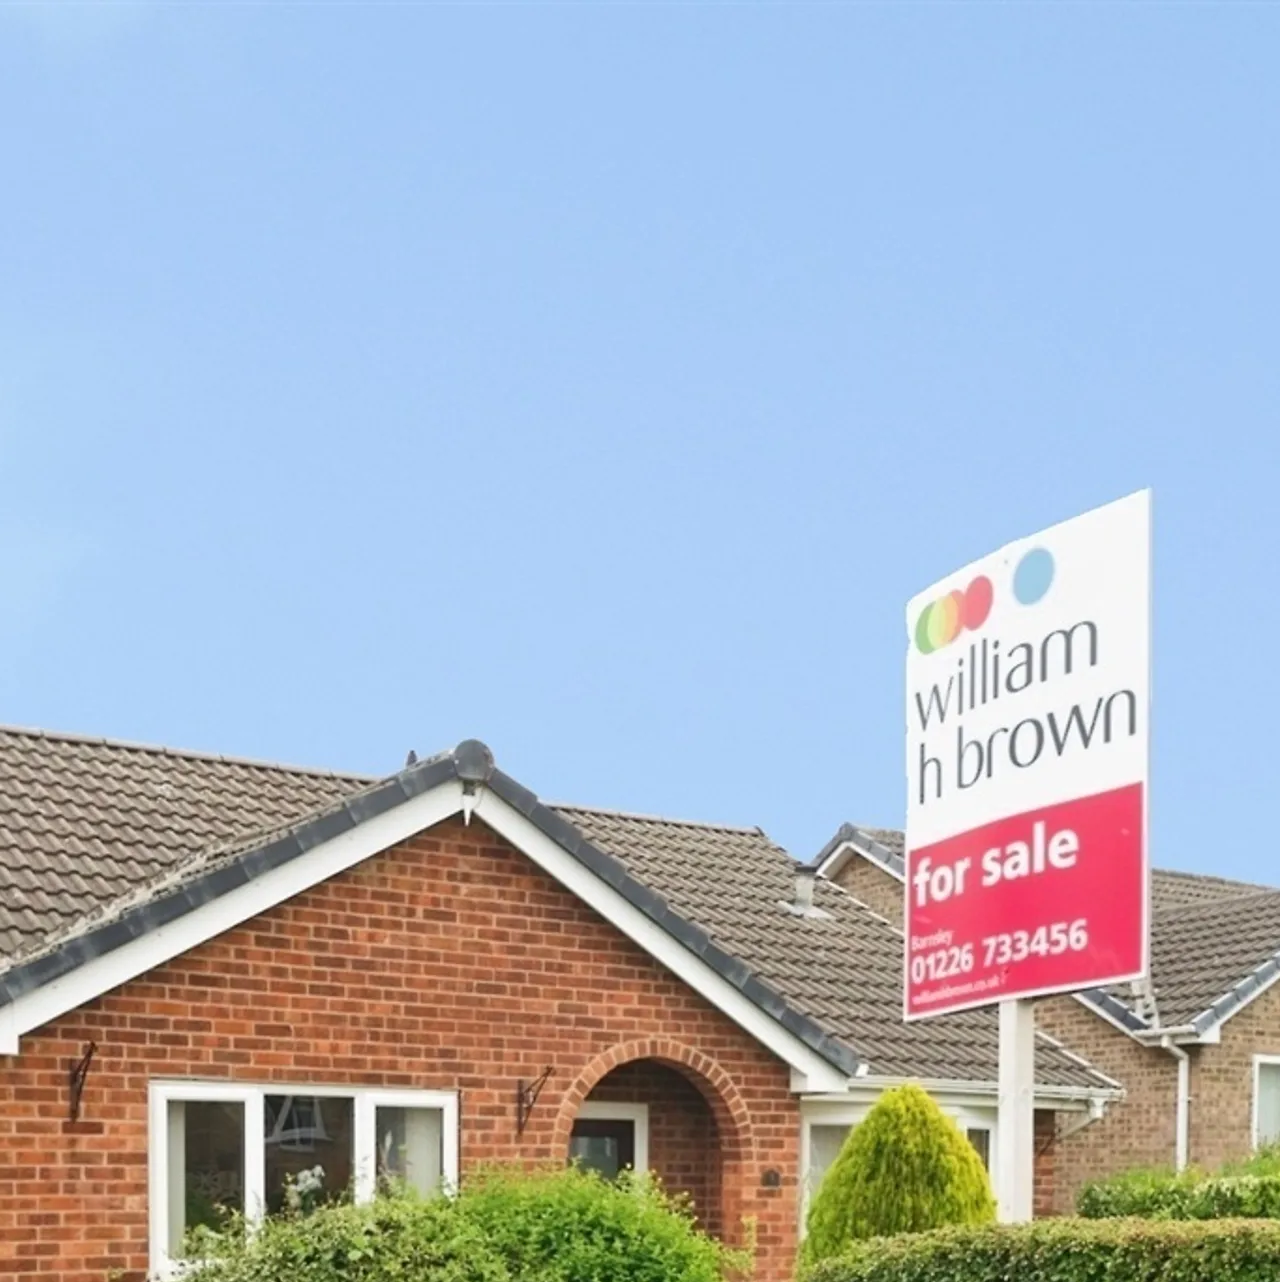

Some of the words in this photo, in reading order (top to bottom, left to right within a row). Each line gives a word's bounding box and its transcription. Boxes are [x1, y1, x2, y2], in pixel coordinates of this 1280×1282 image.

[915, 621, 1097, 732] william
[919, 742, 942, 804] h
[957, 690, 1136, 789] brown
[913, 857, 971, 907] for
[981, 821, 1080, 887] sale
[912, 942, 974, 984] 01226
[982, 918, 1089, 968] 733456
